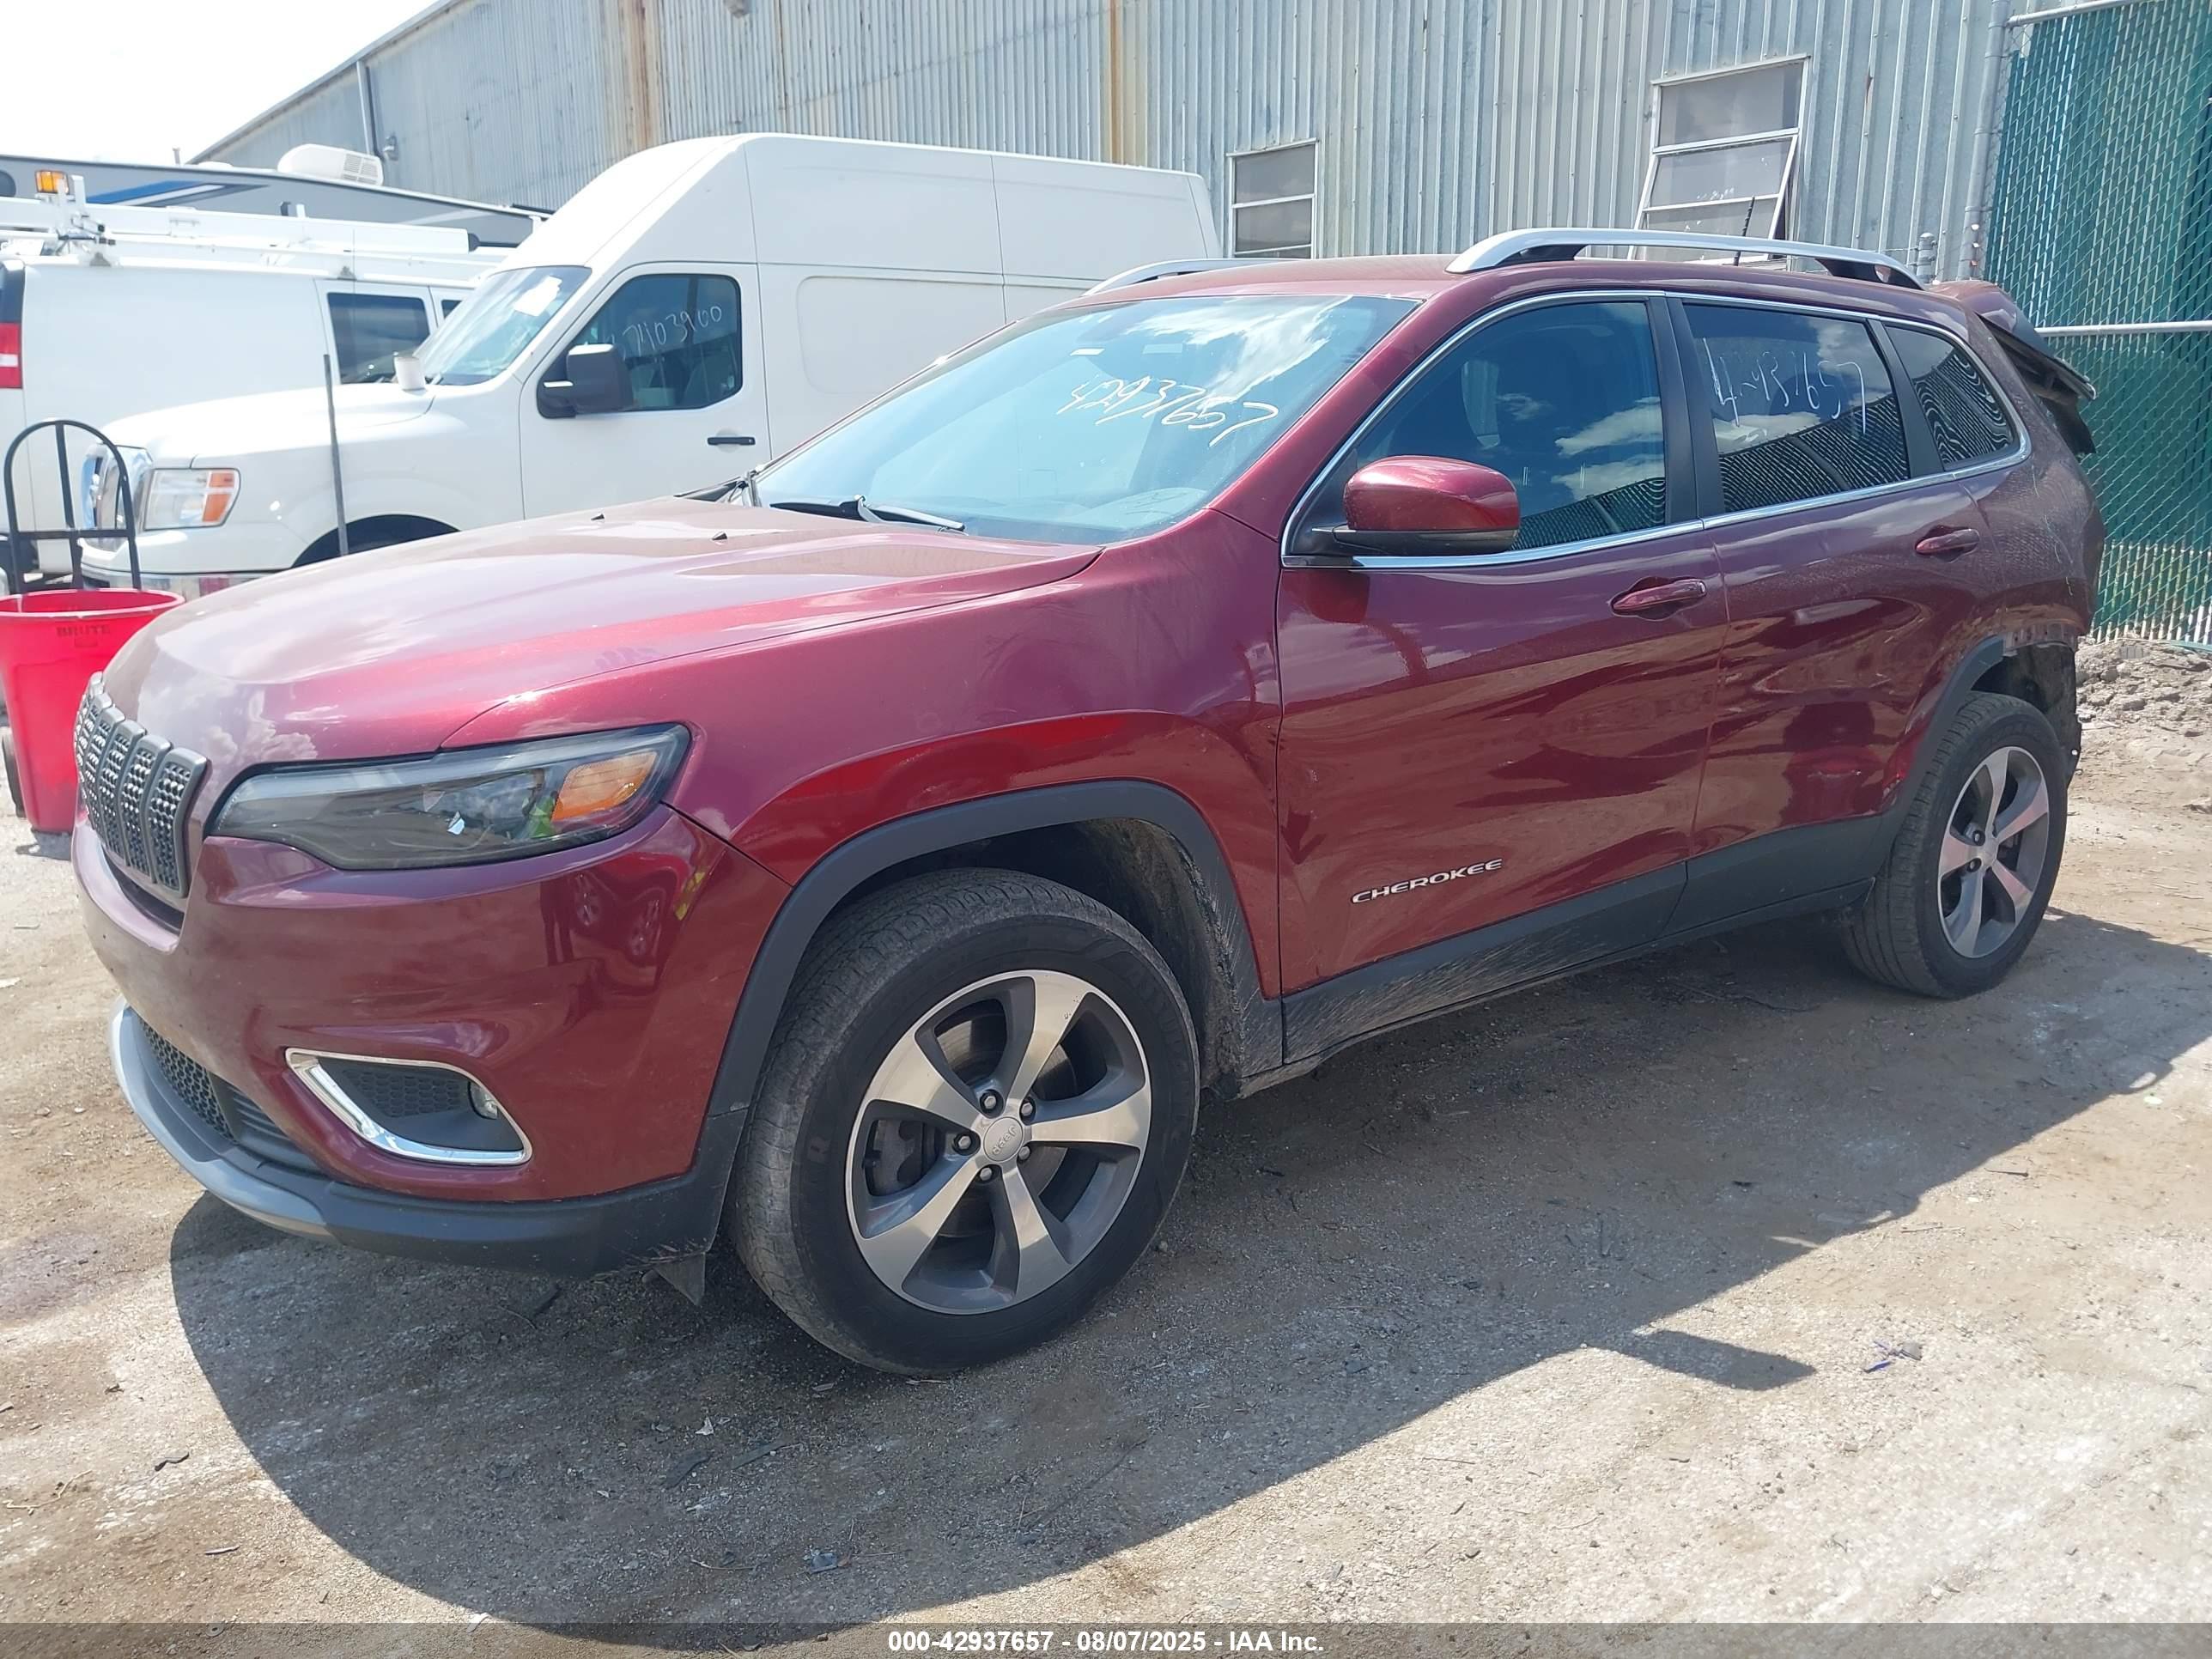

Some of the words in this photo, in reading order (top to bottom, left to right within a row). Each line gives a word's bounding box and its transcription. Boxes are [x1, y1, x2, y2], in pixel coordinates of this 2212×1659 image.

[56, 624, 111, 638] BRUTE
[1350, 858, 1504, 904] CHEROKEE
[992, 1124, 1017, 1156] Jeep
